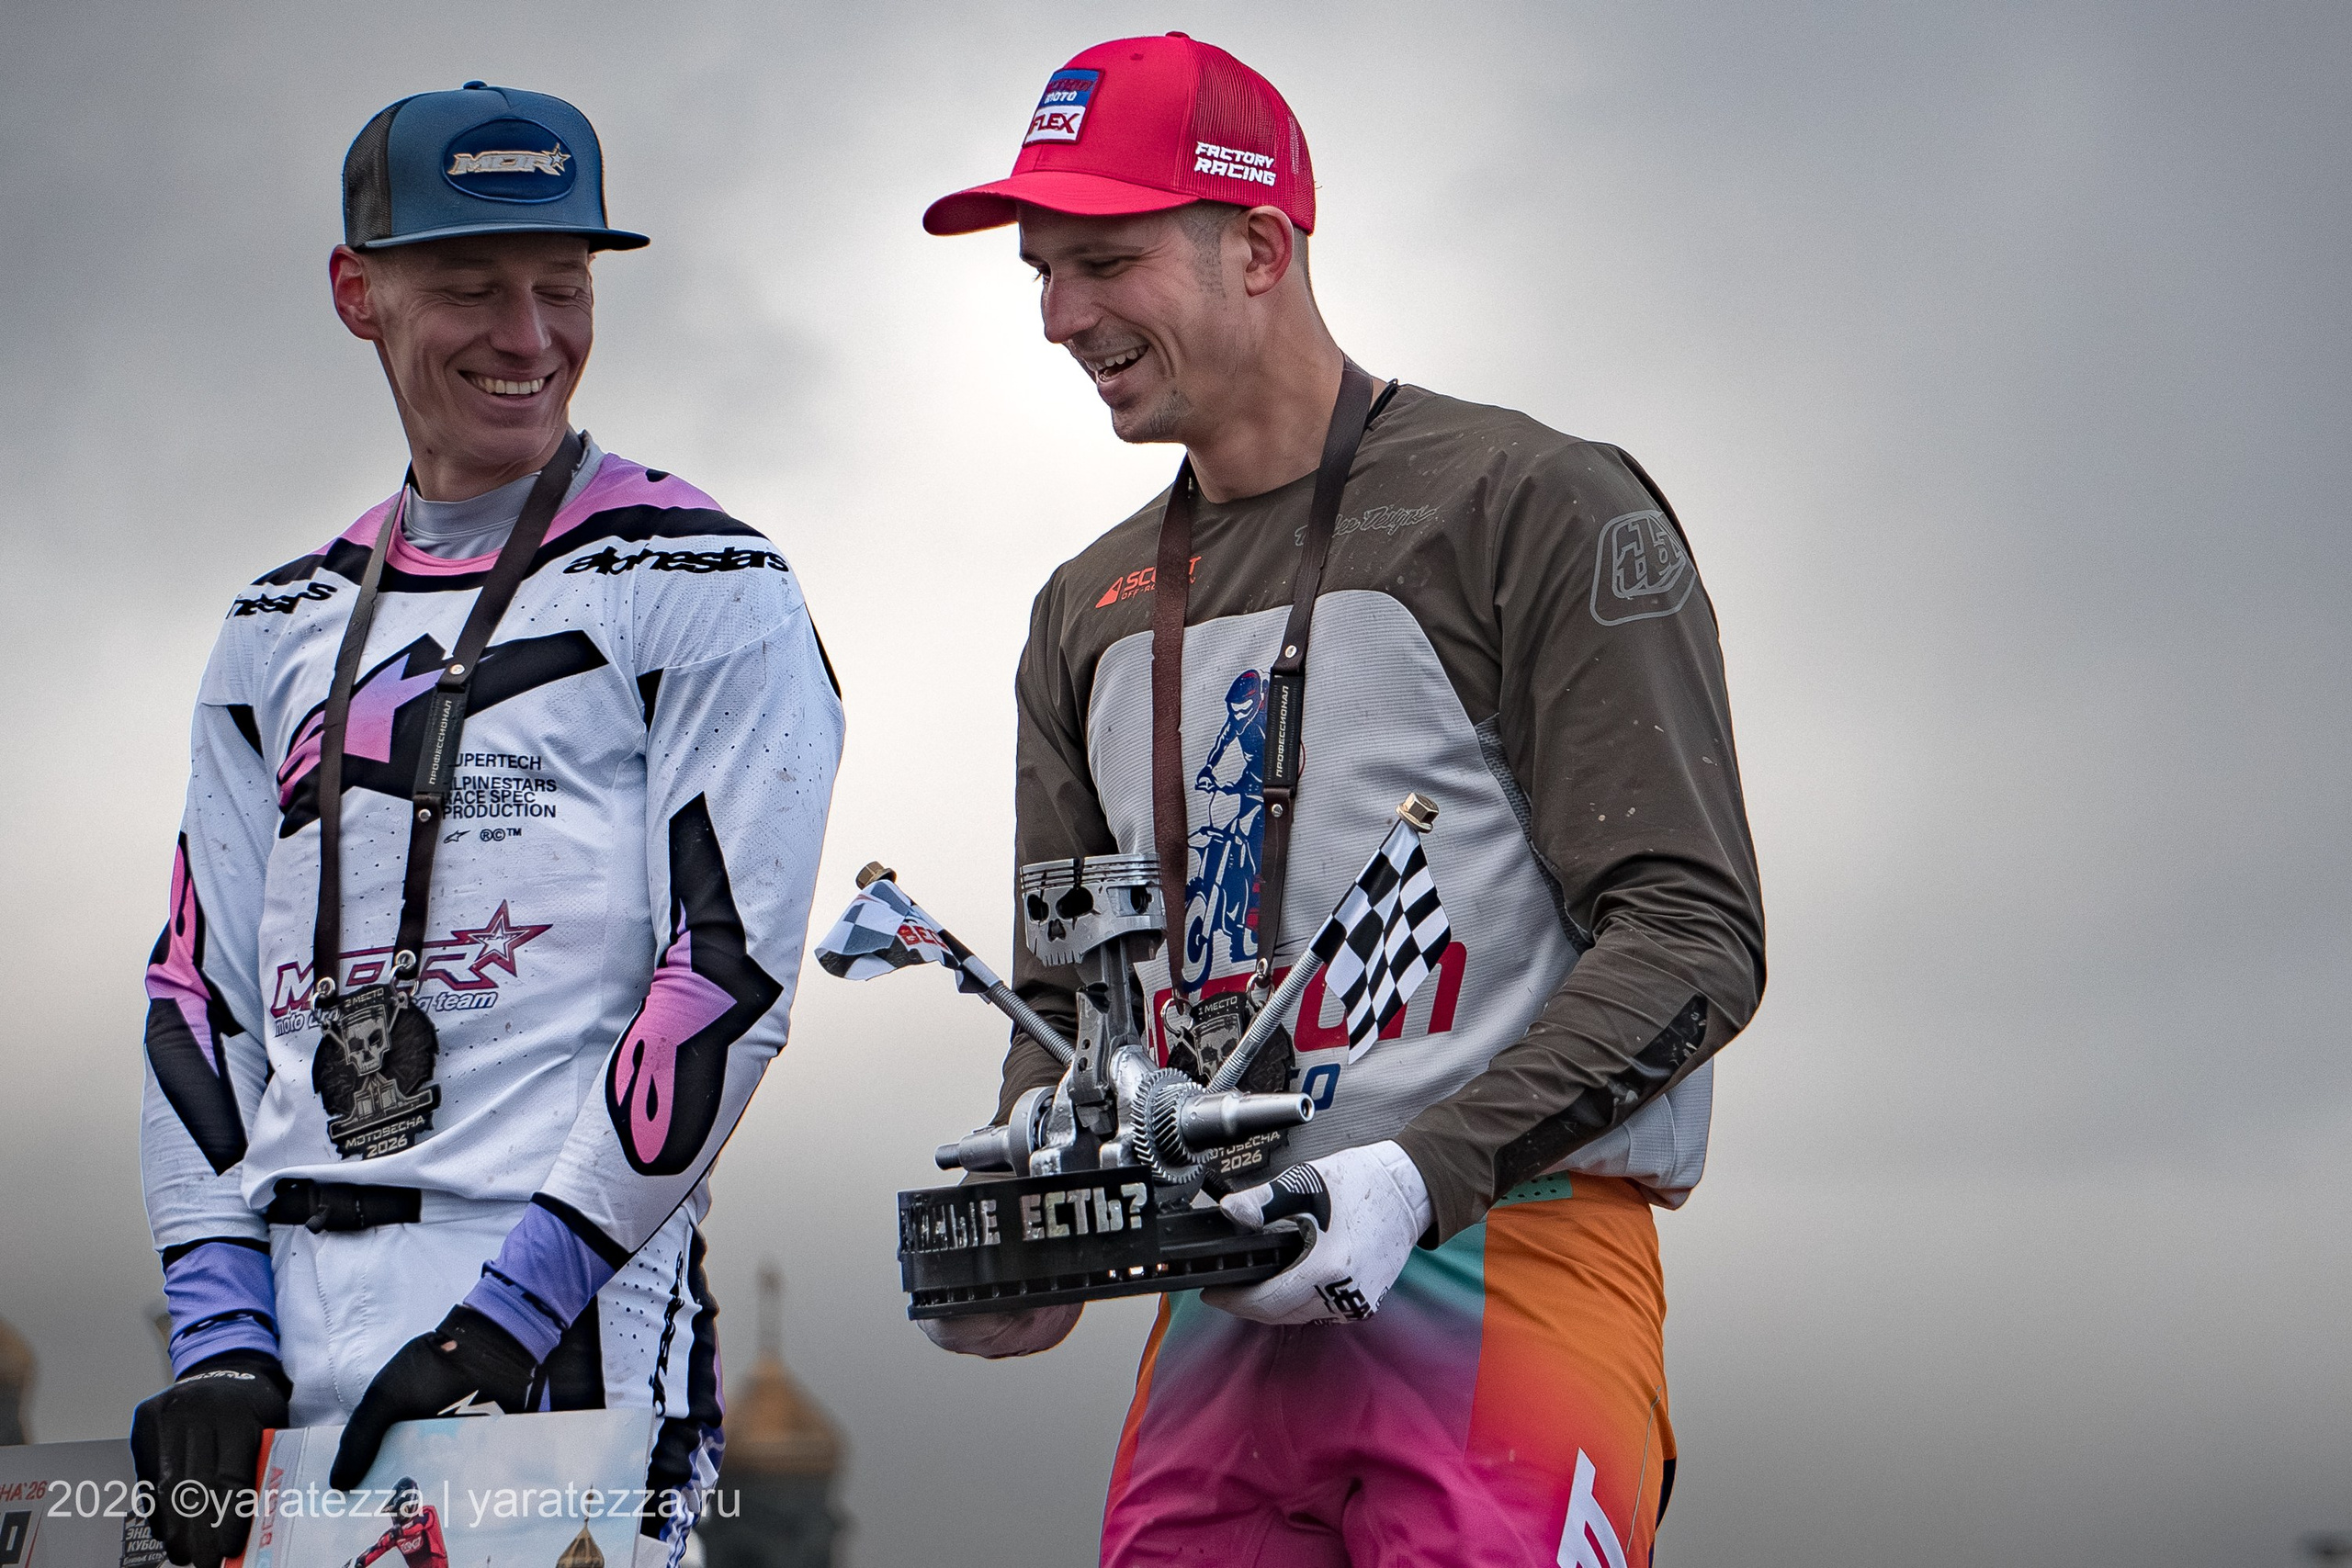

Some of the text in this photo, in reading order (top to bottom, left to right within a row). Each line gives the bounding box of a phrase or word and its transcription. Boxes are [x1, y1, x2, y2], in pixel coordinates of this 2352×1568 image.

[1028, 112, 1080, 135] FLEX
[1195, 141, 1274, 169] FACTORY
[1194, 156, 1276, 186] RACING
[1124, 556, 1202, 592] SCT
[428, 699, 452, 785] ПРОФЕССИОНАЛ
[1275, 685, 1289, 778] ПРОФЕССИОНАЛ
[454, 752, 542, 771] UPERTECH
[450, 775, 558, 792] LPINESTARS
[490, 789, 536, 804] SPEC
[442, 803, 557, 819] PRODUCTION
[435, 992, 498, 1012] team
[1204, 995, 1238, 1014] МЕСТО
[367, 1134, 408, 1158] 2026
[1220, 1149, 1262, 1173] 2026
[1019, 1181, 1148, 1241] ЕСТЬ?
